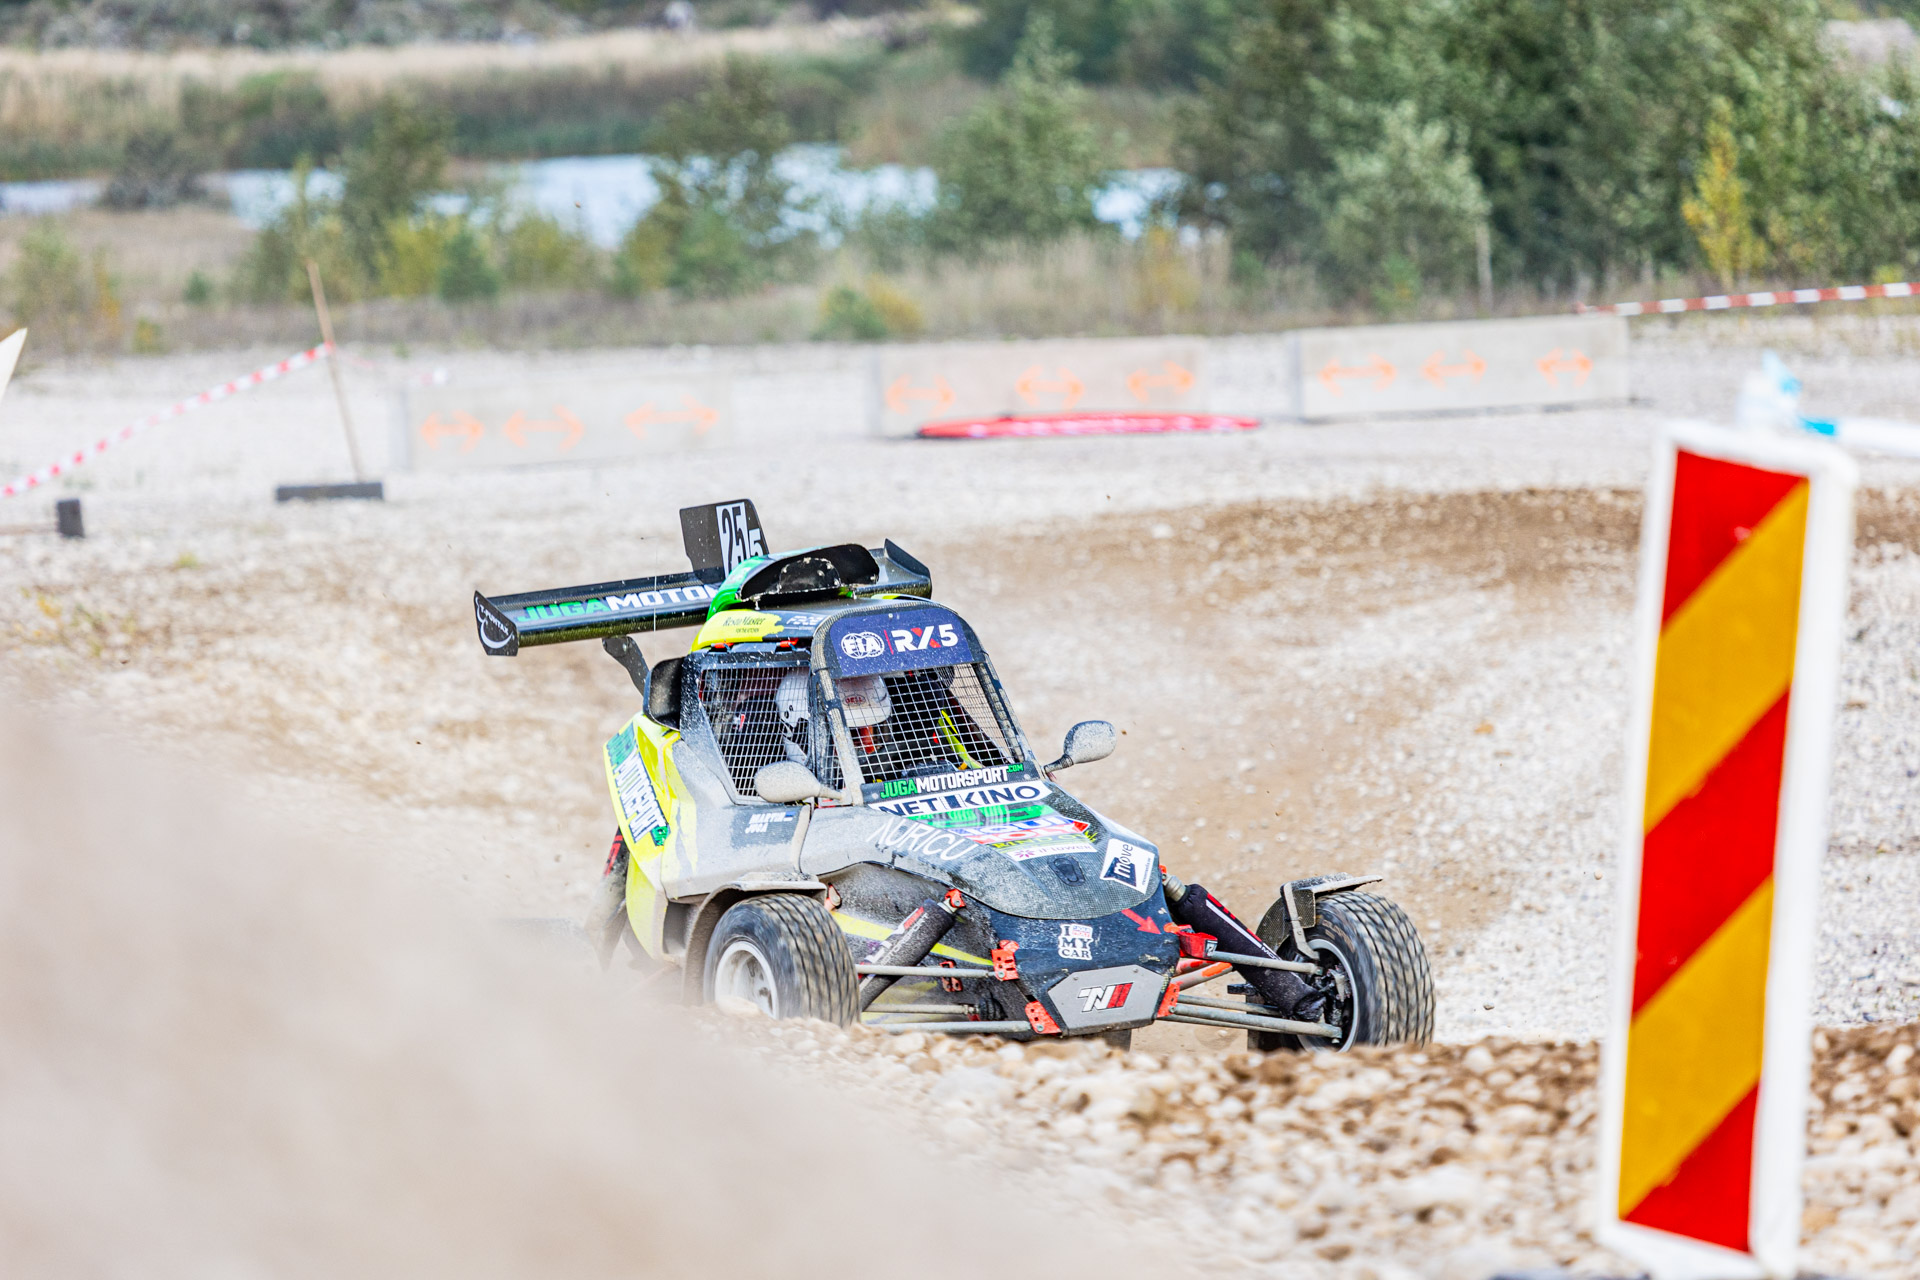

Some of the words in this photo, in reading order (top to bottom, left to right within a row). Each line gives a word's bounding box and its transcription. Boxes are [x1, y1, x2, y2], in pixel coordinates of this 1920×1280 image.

[721, 507, 747, 574] 25
[842, 635, 881, 655] FIA
[891, 623, 959, 653] RX5
[1113, 843, 1134, 879] move
[1061, 937, 1092, 949] MY
[1061, 948, 1090, 958] CAR
